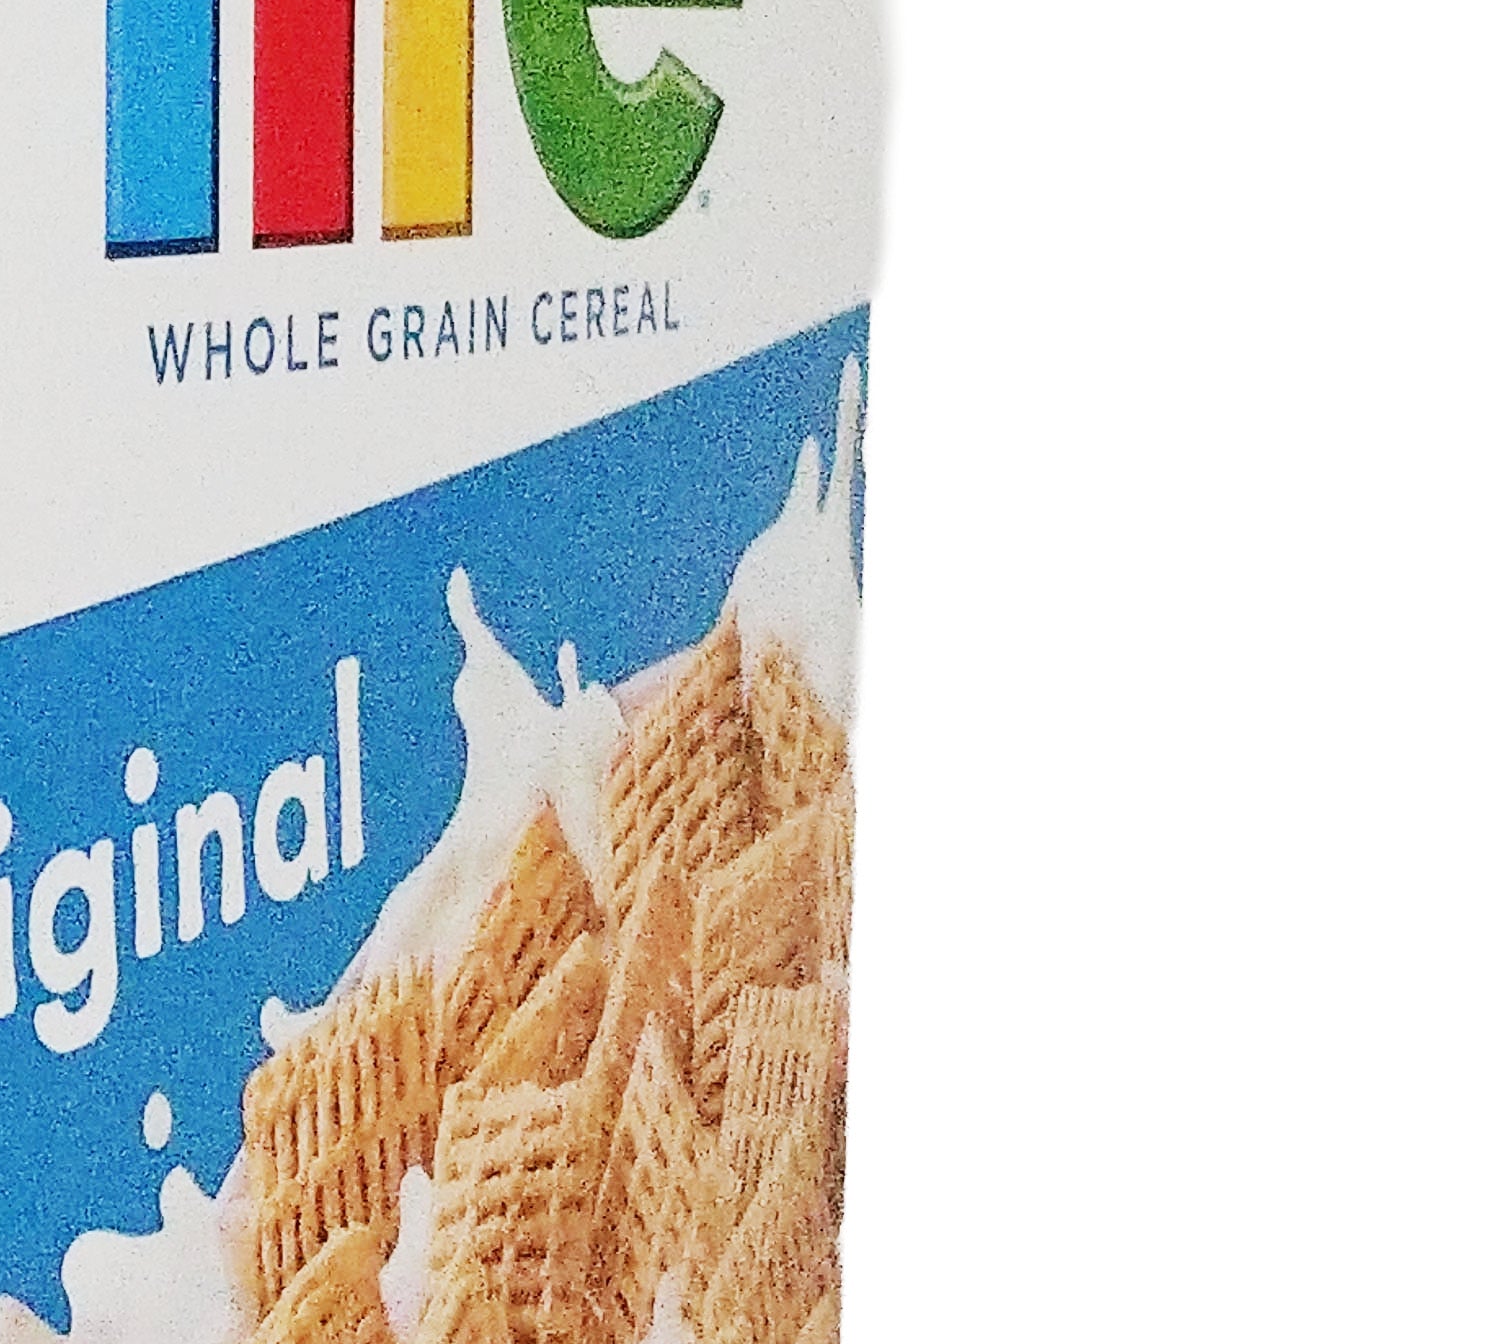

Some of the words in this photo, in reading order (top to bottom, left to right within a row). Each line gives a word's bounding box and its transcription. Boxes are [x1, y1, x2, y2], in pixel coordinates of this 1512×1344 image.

[147, 310, 340, 385] WHOLE
[365, 293, 510, 363] GRAIN
[529, 279, 680, 347] CEREAL
